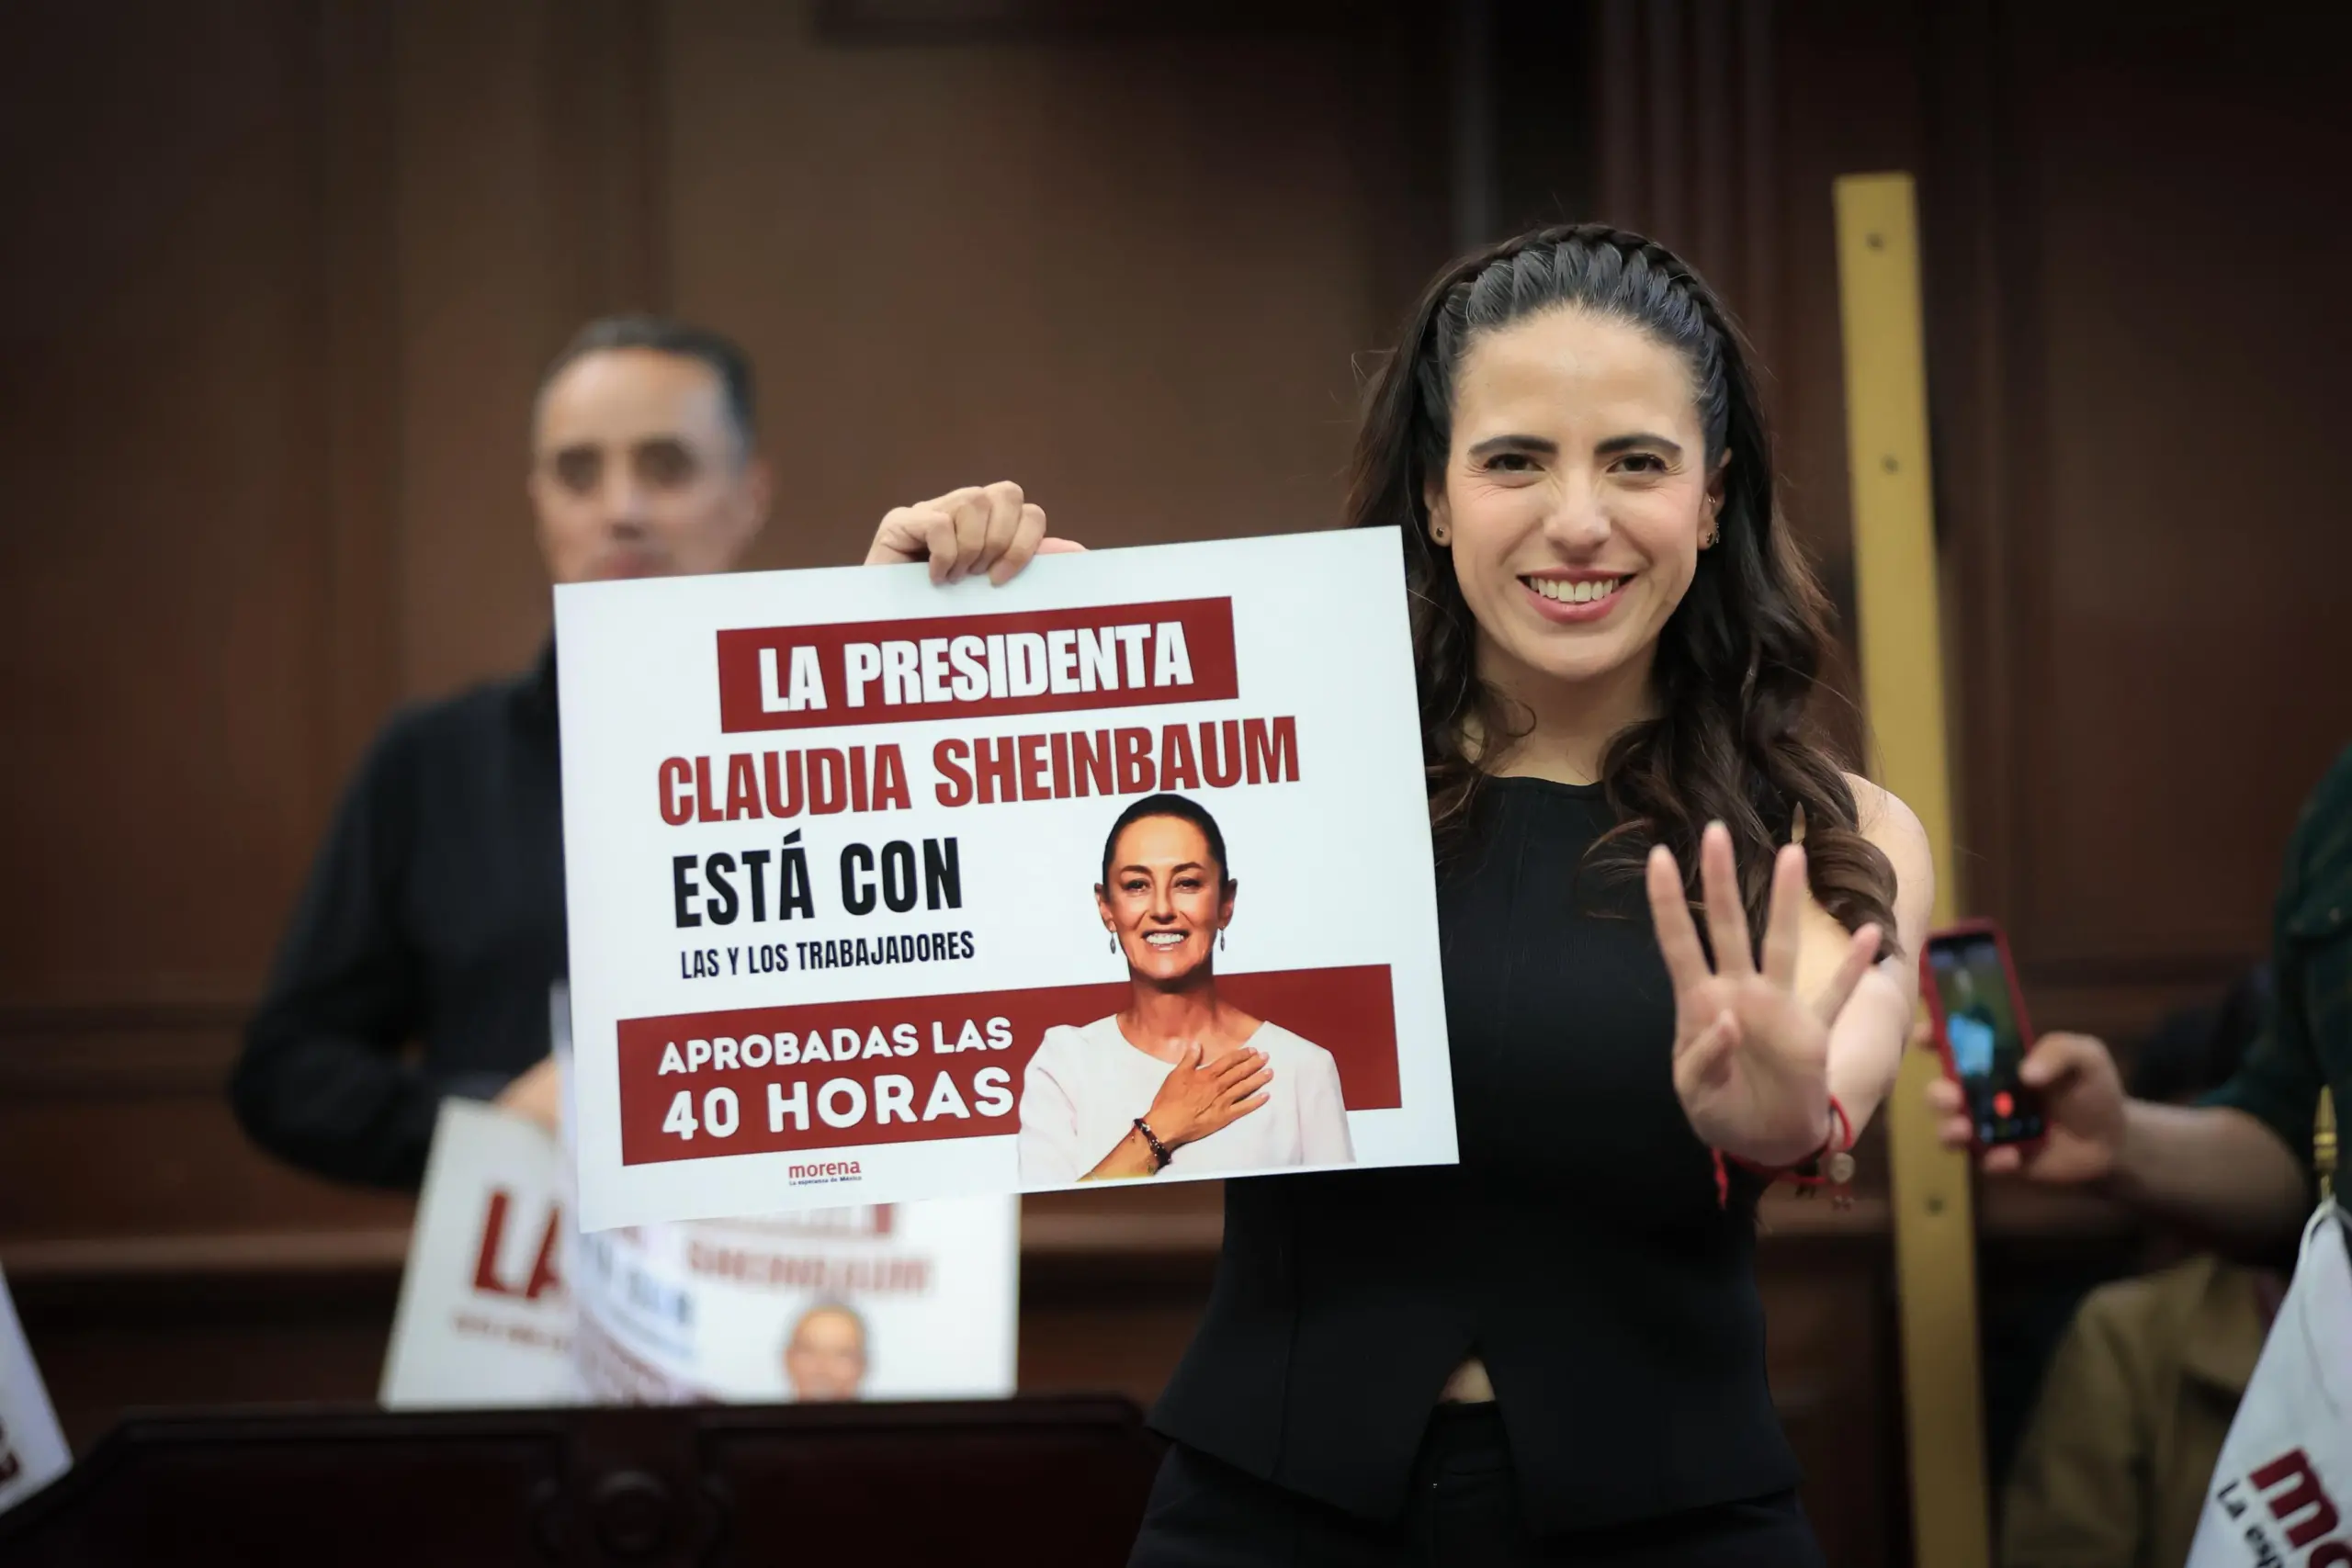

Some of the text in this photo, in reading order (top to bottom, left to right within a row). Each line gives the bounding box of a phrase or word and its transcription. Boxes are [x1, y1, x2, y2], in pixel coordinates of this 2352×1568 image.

[758, 621, 1194, 713] LA PRESIDENTA
[658, 716, 1300, 826] CLAUDIA SHEINBAUM
[673, 828, 962, 929] ESTÁ CON
[681, 931, 975, 979] LAS Y LOS TRABAJADORES
[658, 1016, 1012, 1076] APROBADAS LAS
[662, 1066, 1013, 1140] 40 HORAS
[788, 1160, 861, 1179] morena
